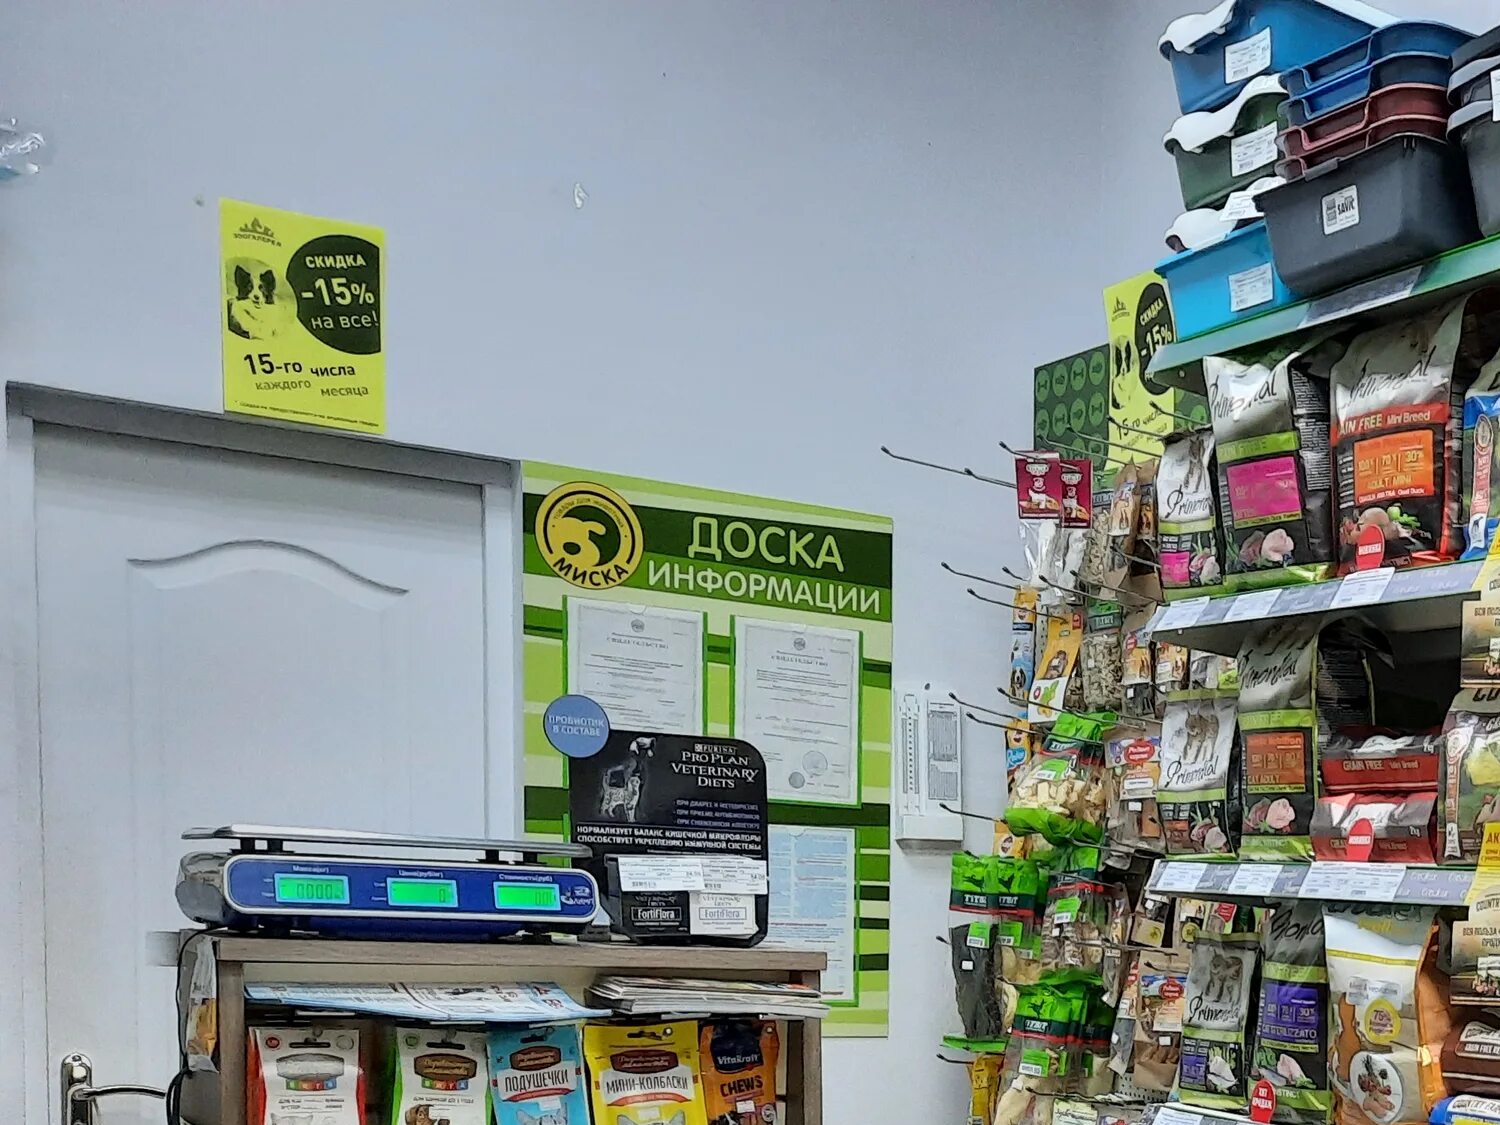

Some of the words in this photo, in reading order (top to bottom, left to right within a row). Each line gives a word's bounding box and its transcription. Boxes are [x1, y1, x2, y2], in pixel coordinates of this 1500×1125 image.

[304, 252, 367, 269] СКИДКА
[300, 276, 375, 308] -15%
[311, 314, 334, 330] на
[338, 311, 379, 330] все!
[1138, 297, 1164, 328] СКИДКА
[243, 352, 303, 377] 15-го
[309, 362, 356, 379] числа
[255, 378, 312, 392] каждого
[320, 384, 369, 398] месяца
[687, 515, 846, 573] ДОСКА
[552, 556, 630, 588] МИСКА
[647, 559, 881, 615] ИНФОРМАЦИИ
[671, 763, 759, 783] VETERINARY
[504, 1068, 569, 1094] ПОДУШЕЧКИ
[605, 1075, 689, 1095] МИНИ-КОЛБАСКИ
